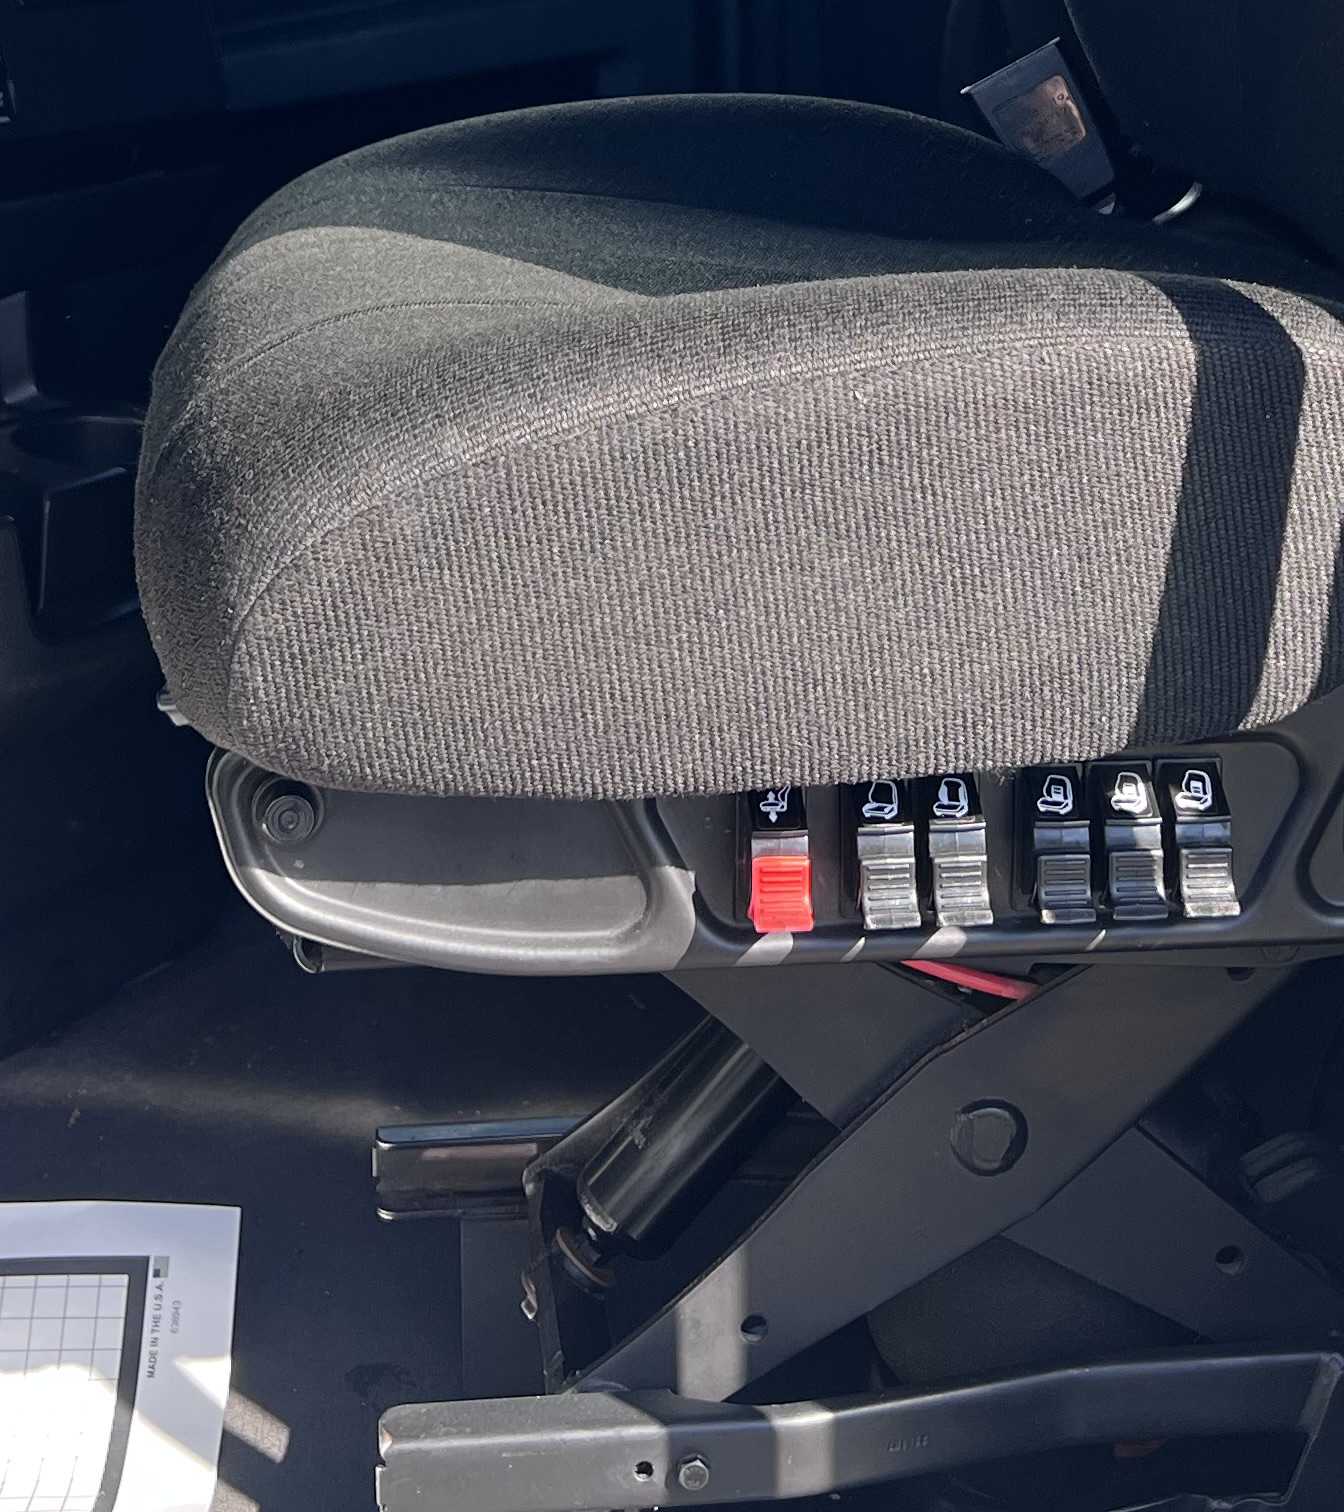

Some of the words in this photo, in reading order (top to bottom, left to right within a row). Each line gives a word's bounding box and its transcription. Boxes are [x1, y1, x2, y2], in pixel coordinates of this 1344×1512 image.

[151, 1313, 162, 1336] THE
[150, 1337, 159, 1349] IN
[146, 1351, 158, 1378] MADE
